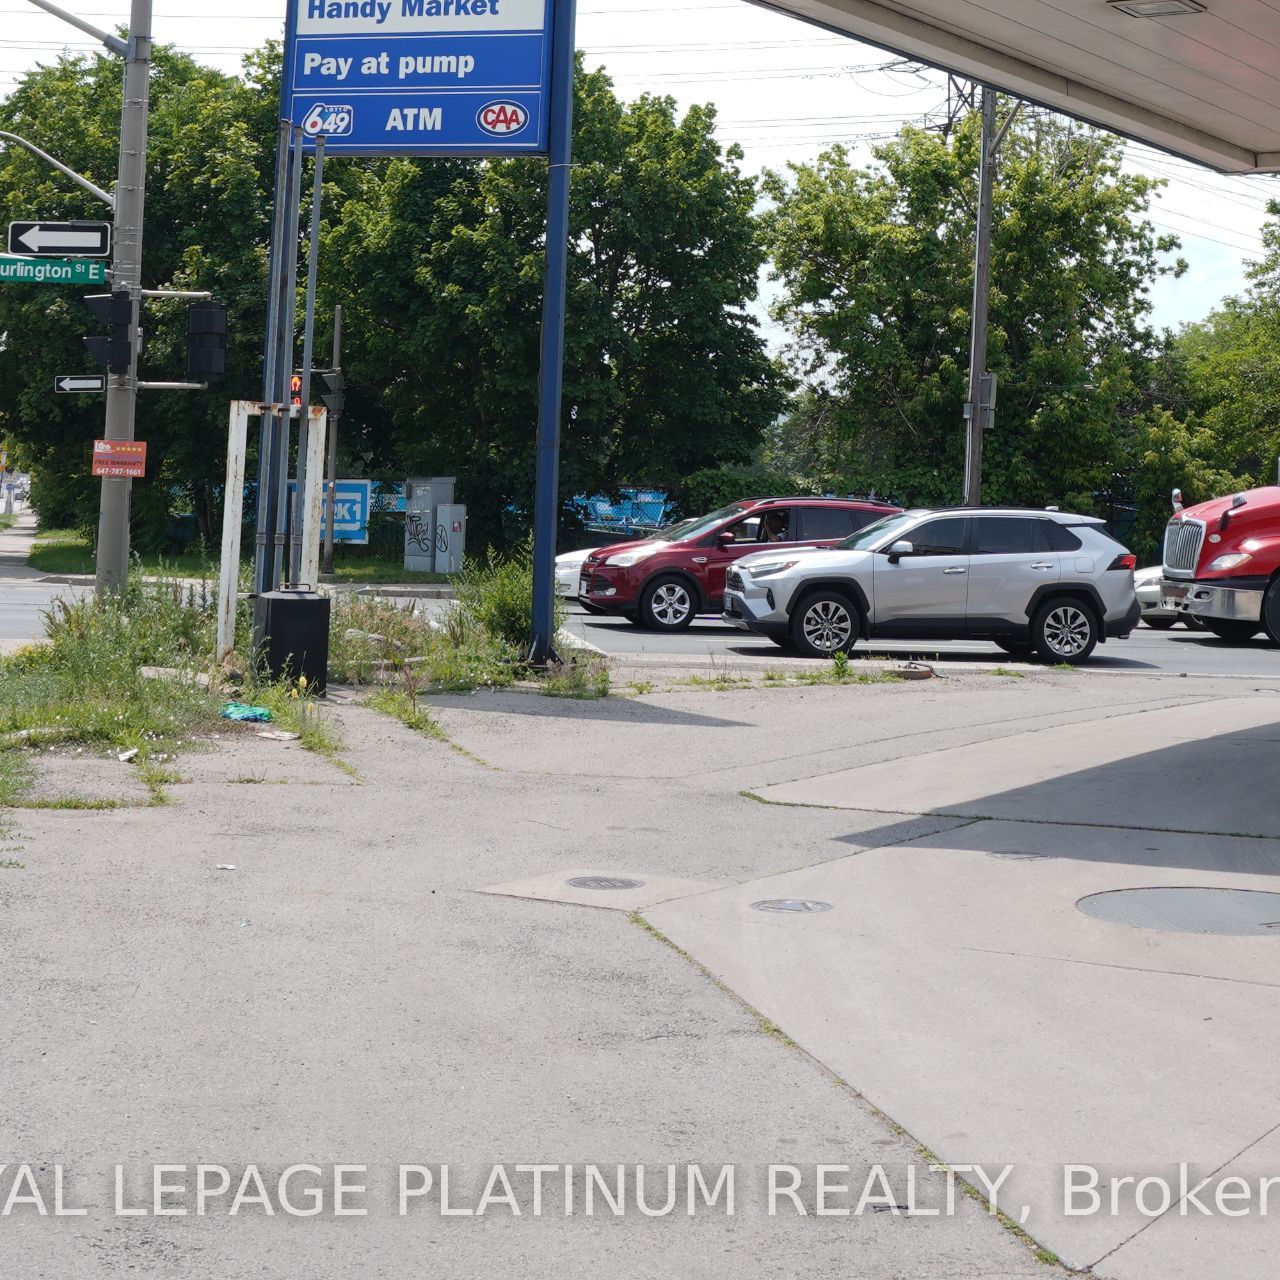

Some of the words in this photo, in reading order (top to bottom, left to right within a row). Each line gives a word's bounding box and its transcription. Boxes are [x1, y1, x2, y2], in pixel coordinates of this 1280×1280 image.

[304, 52, 353, 80] Pay
[360, 52, 390, 74] at
[398, 54, 475, 79] pump
[385, 107, 442, 131] ATM
[483, 105, 522, 130] CAA
[75, 264, 86, 273] St
[89, 265, 99, 279] E
